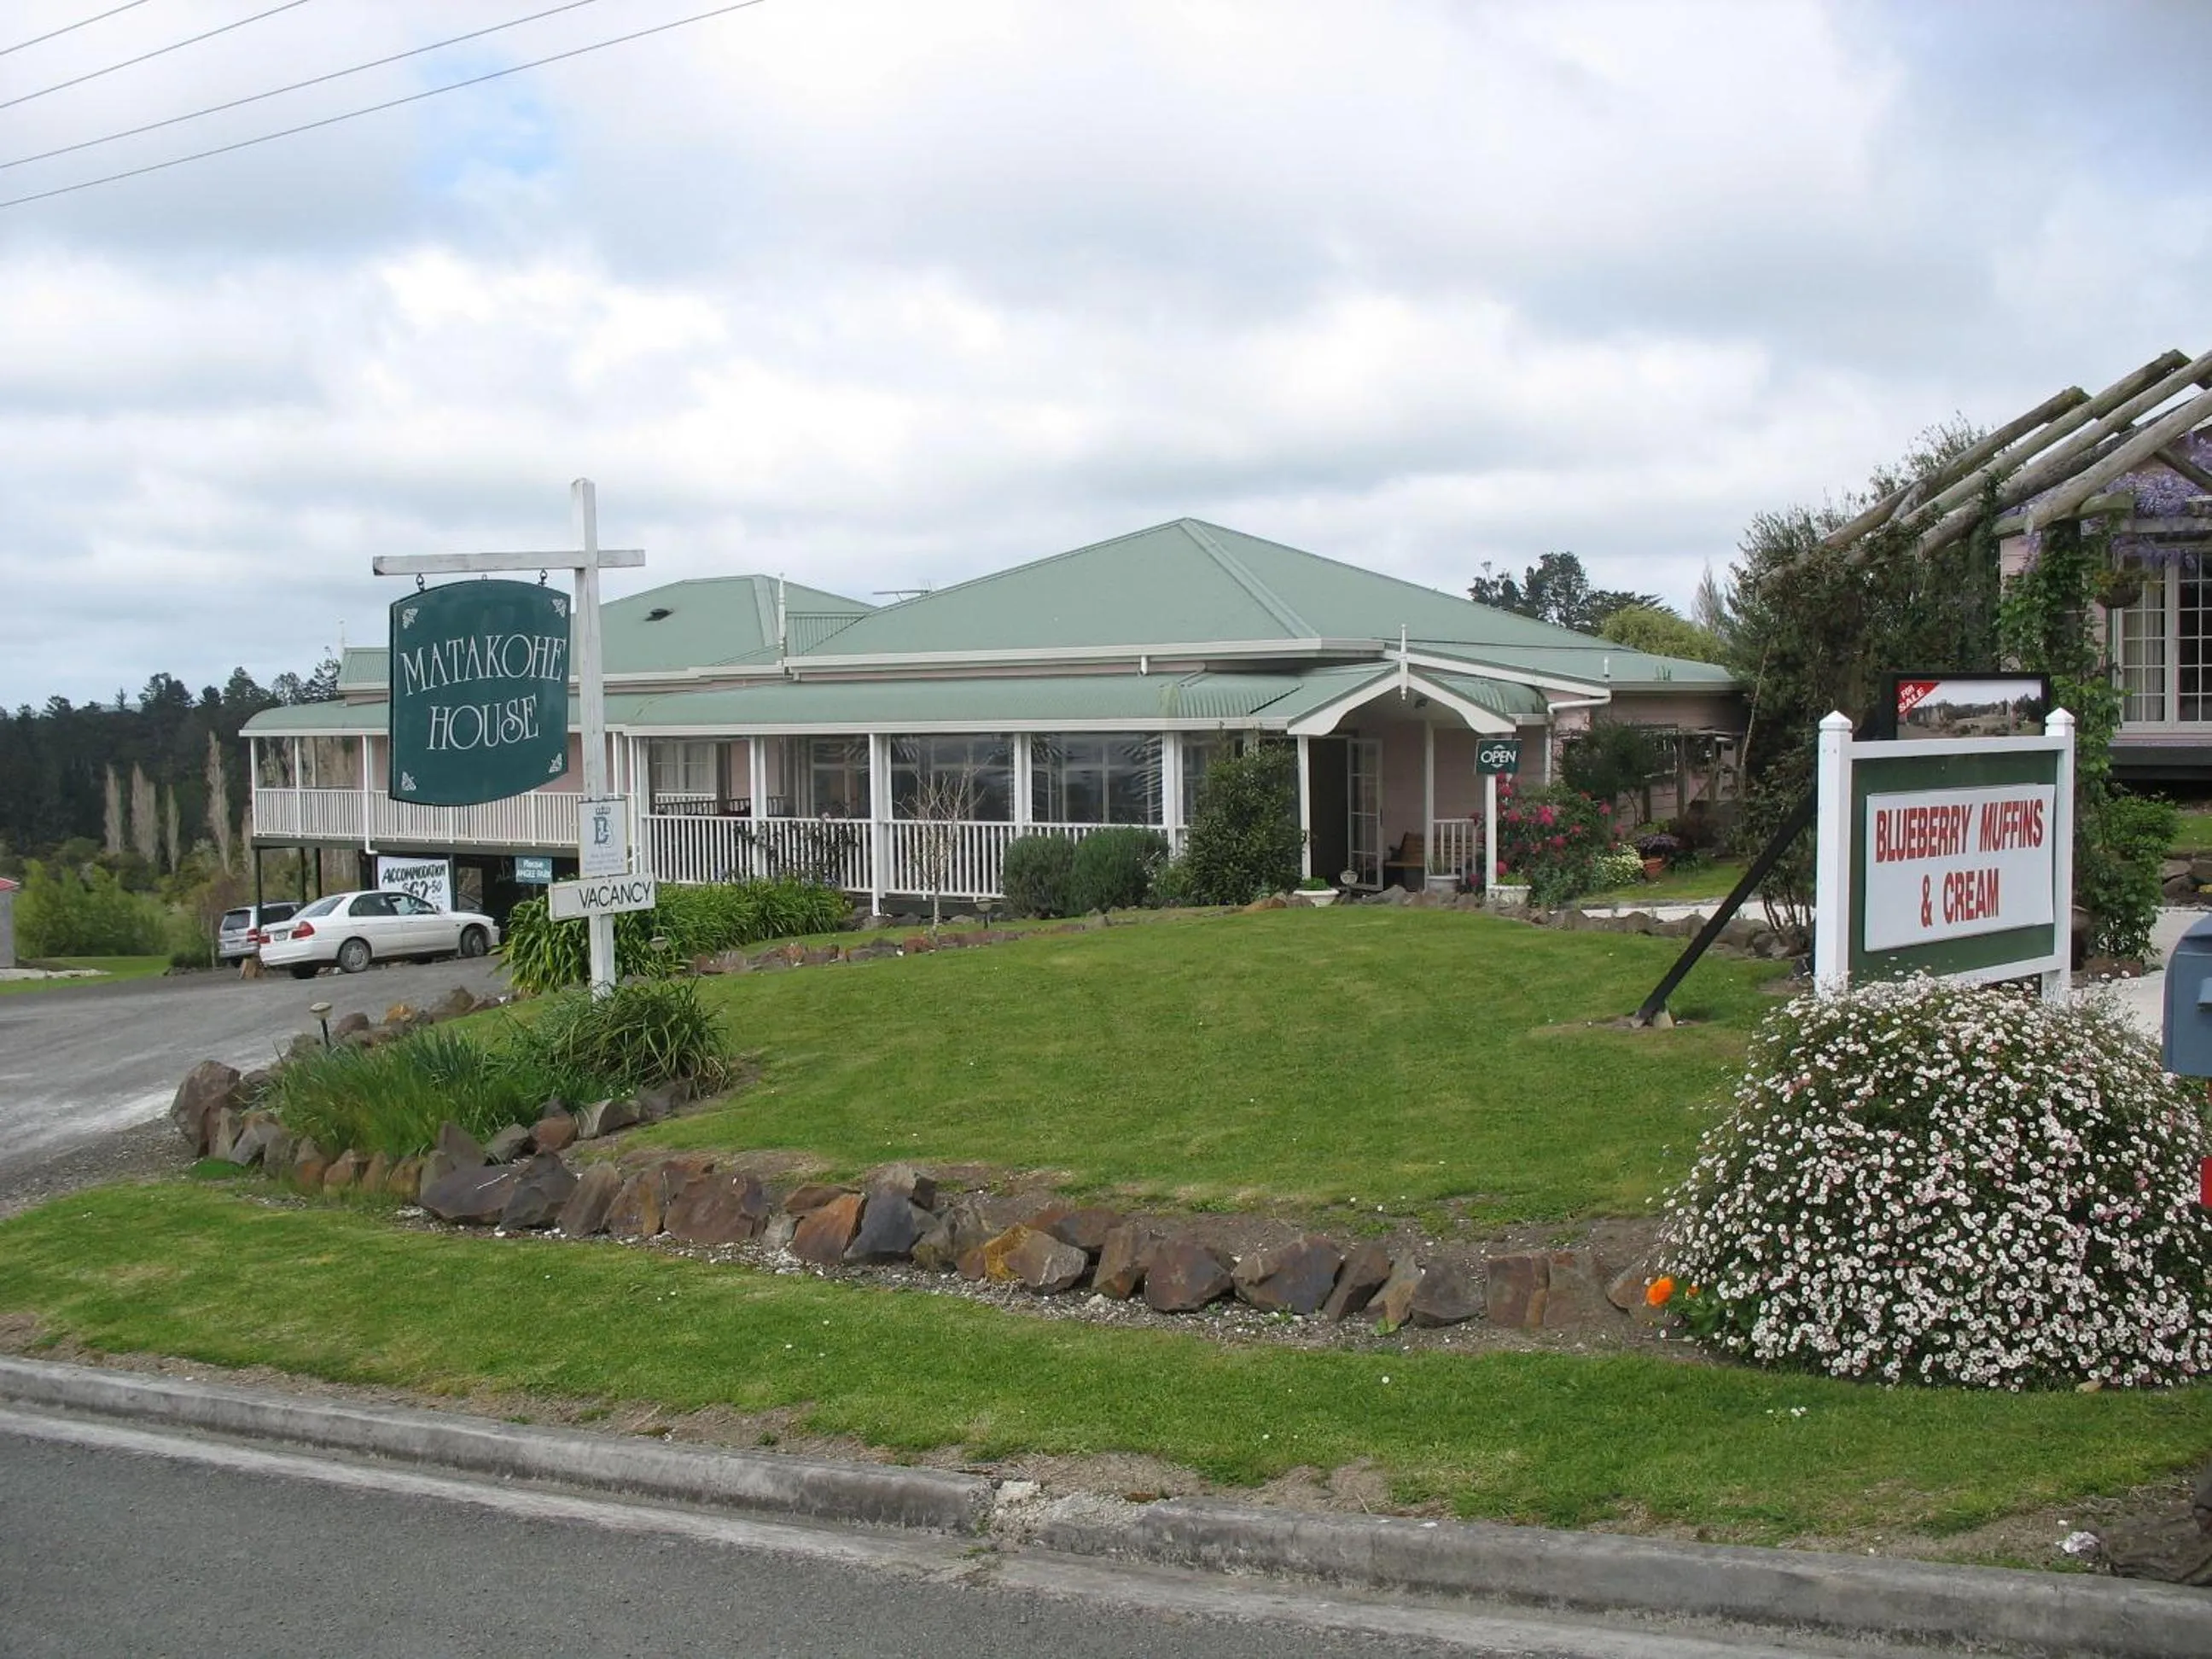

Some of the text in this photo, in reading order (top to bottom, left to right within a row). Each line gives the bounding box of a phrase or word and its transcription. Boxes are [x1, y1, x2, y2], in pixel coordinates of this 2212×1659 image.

[400, 634, 567, 696] MATAKOHE
[1898, 686, 1925, 713] SALE
[1901, 684, 1915, 699] FOR
[427, 693, 539, 750] HOUSE
[1480, 749, 1516, 764] OPEN
[1876, 799, 2043, 863] BLUEBERRY MUFFINS
[381, 864, 446, 883] ACCOMMODATION
[579, 882, 651, 909] VACANCY
[1921, 868, 1999, 928] & CREAM
